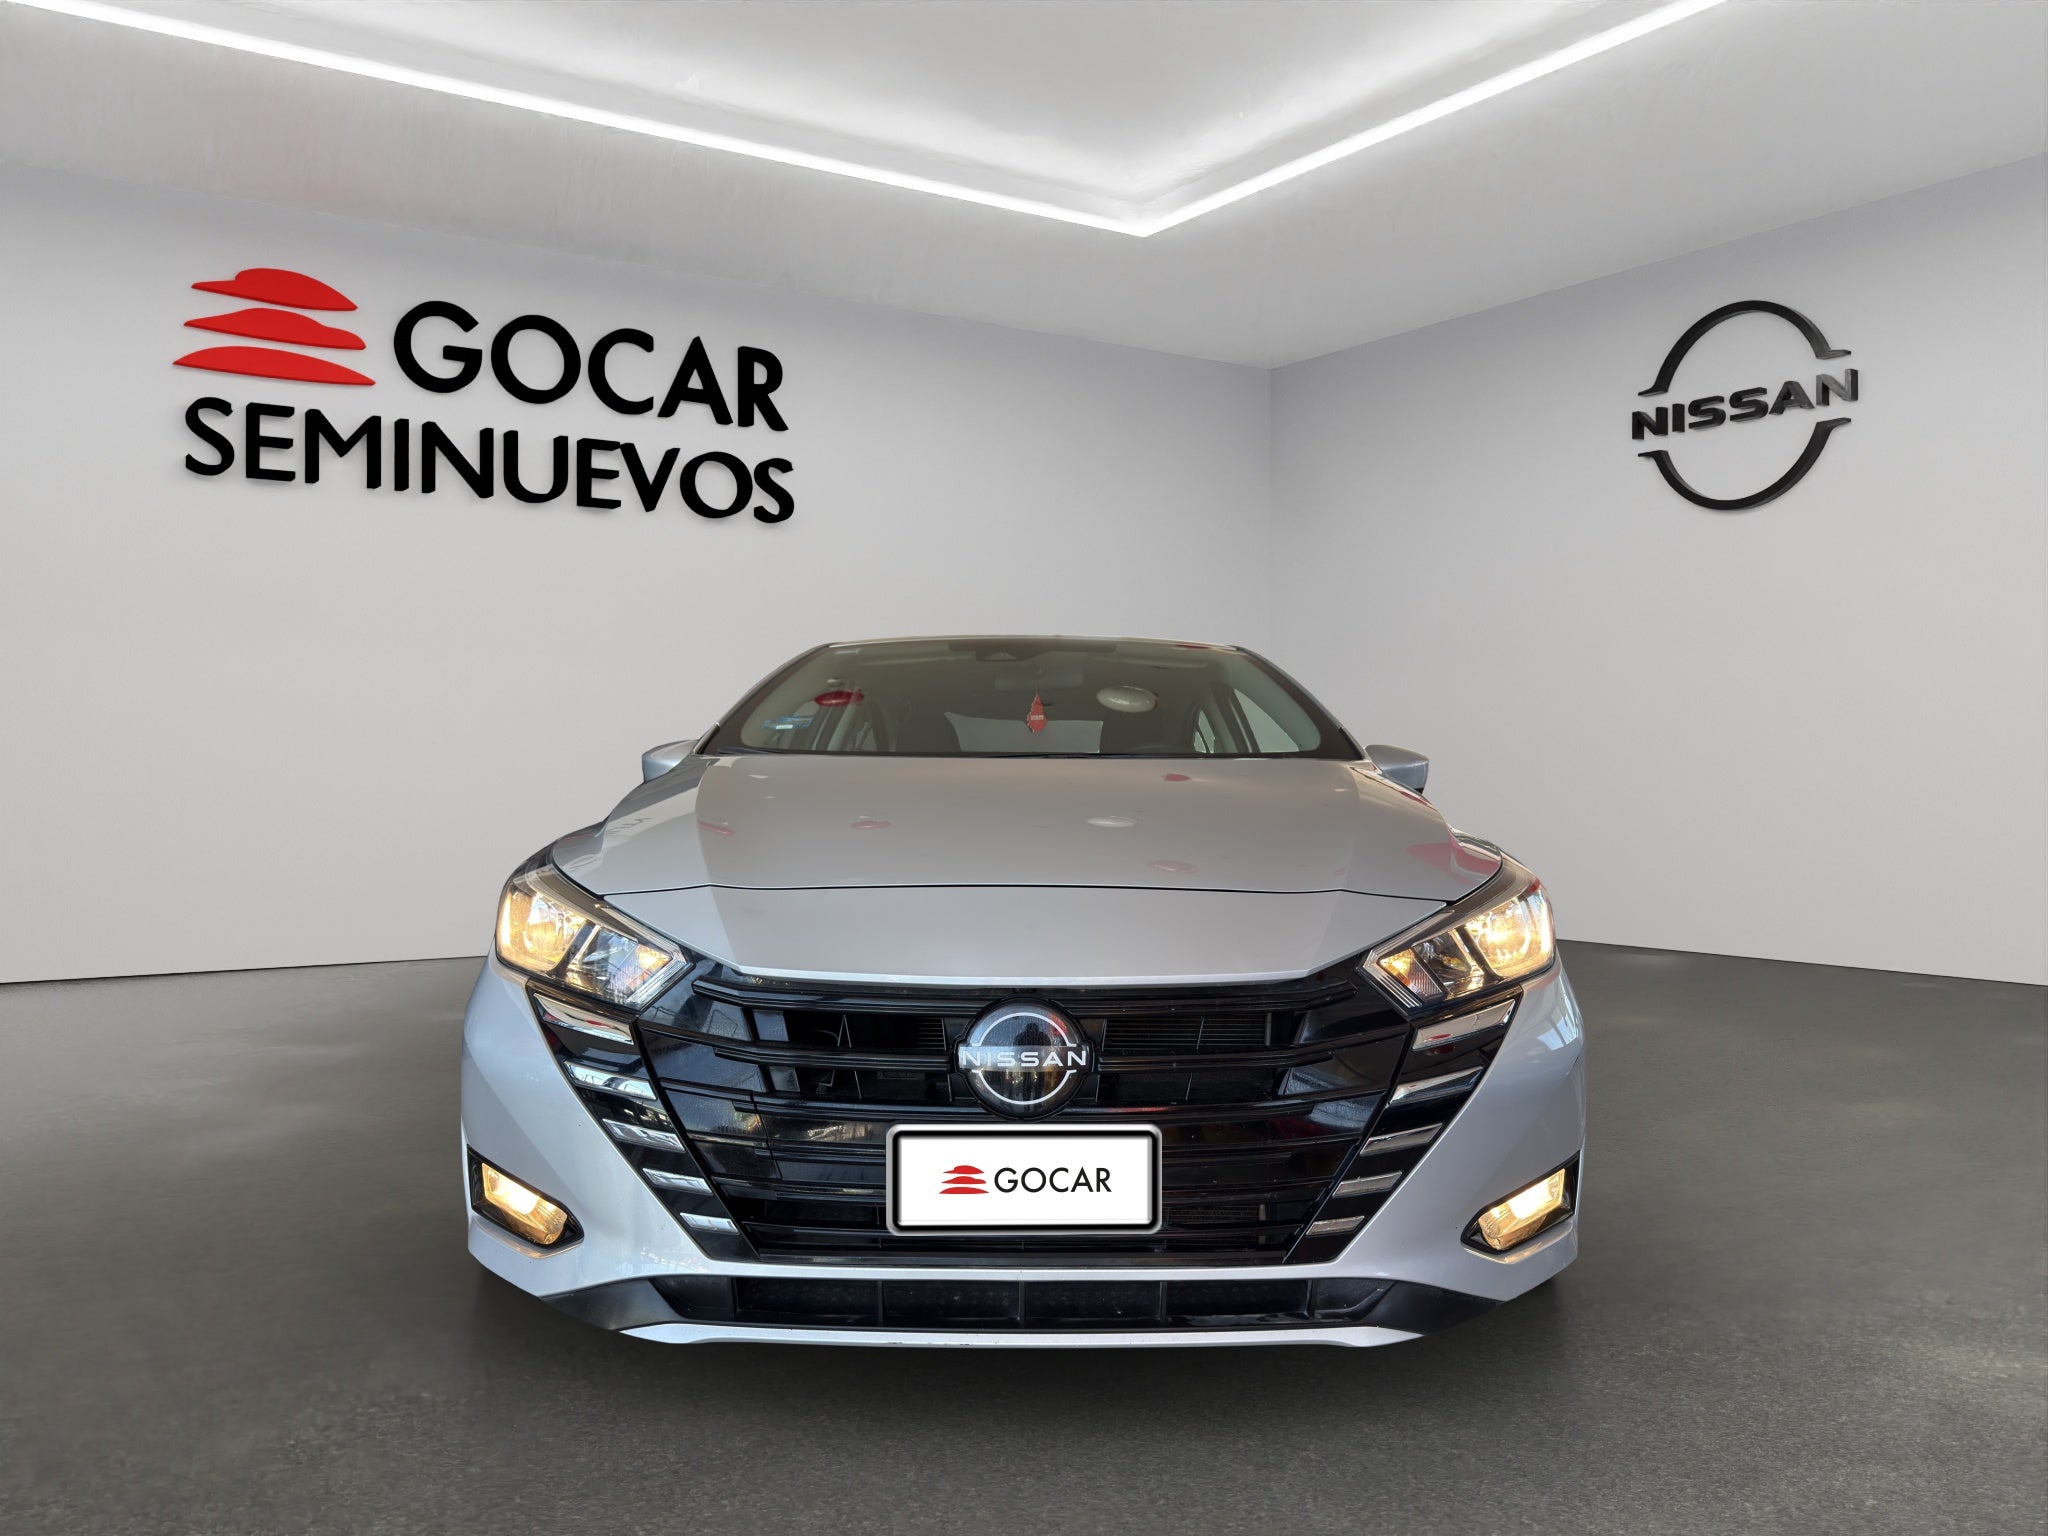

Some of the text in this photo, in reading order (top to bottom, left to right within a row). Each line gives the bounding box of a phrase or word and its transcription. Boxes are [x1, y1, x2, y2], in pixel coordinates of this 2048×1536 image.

[393, 301, 789, 432] GOCAR
[1631, 368, 1859, 441] NISSAN
[184, 396, 795, 524] SEMINUEVOS
[960, 1049, 1087, 1068] NISSAN
[994, 1166, 1112, 1194] GOCAR
